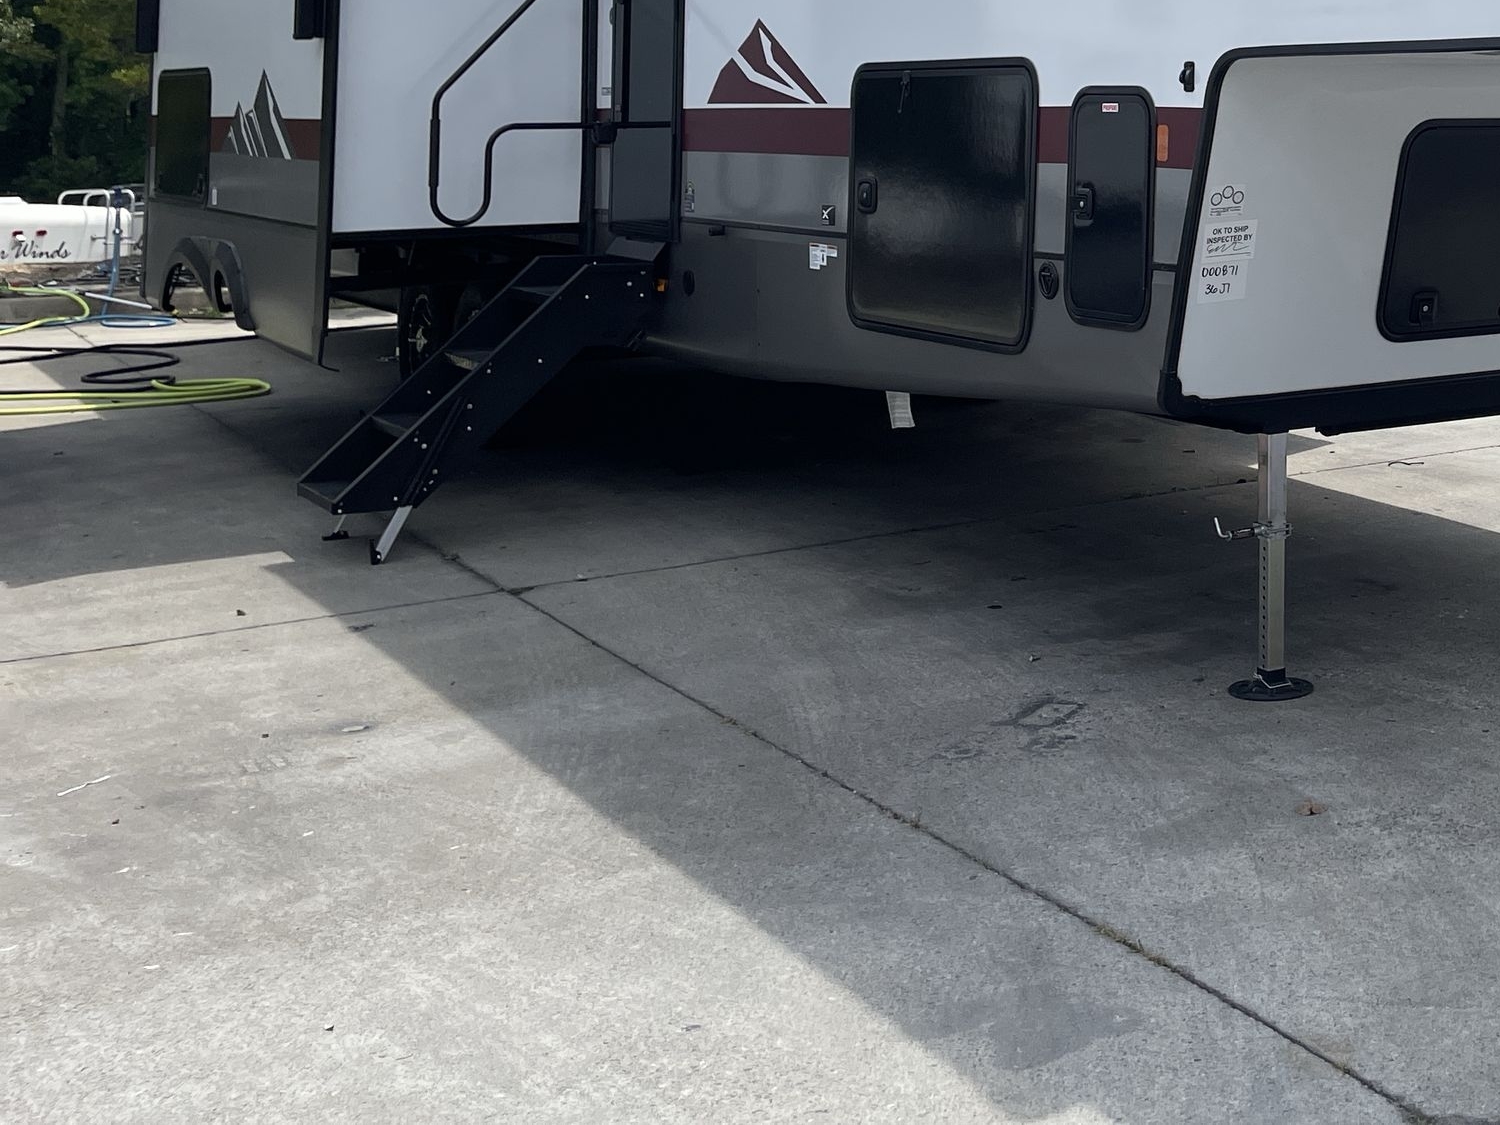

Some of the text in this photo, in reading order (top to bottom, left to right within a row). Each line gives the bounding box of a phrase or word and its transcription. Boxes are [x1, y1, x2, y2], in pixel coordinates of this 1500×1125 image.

[1233, 225, 1249, 233] SHIP
[1206, 235, 1242, 245] INSPECTED
[11, 240, 71, 259] Winds
